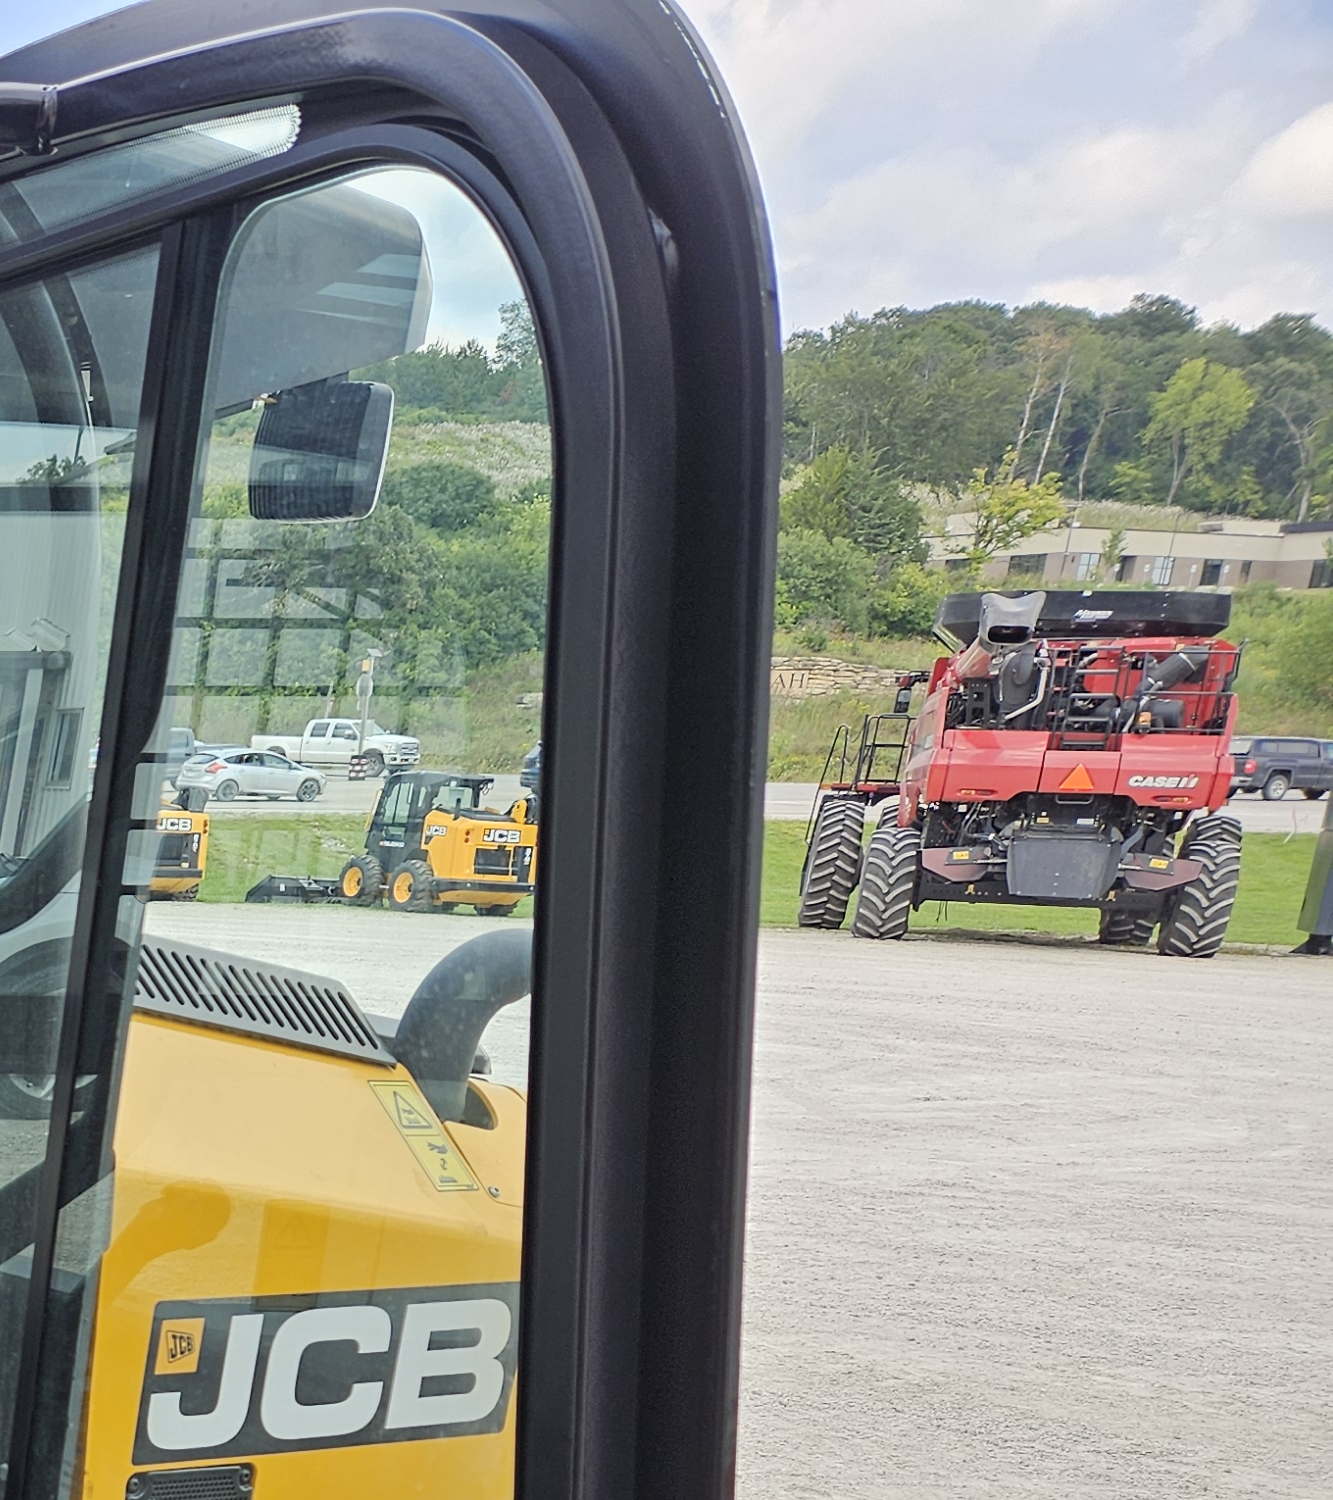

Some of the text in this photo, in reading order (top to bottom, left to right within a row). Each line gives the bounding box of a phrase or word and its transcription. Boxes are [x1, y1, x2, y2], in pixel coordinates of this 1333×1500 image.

[1127, 774, 1180, 788] CASE
[155, 817, 192, 832] JCB
[425, 825, 448, 837] JCB
[482, 828, 521, 844] JCB
[168, 1332, 196, 1360] JCB
[147, 1298, 513, 1451] JCB
